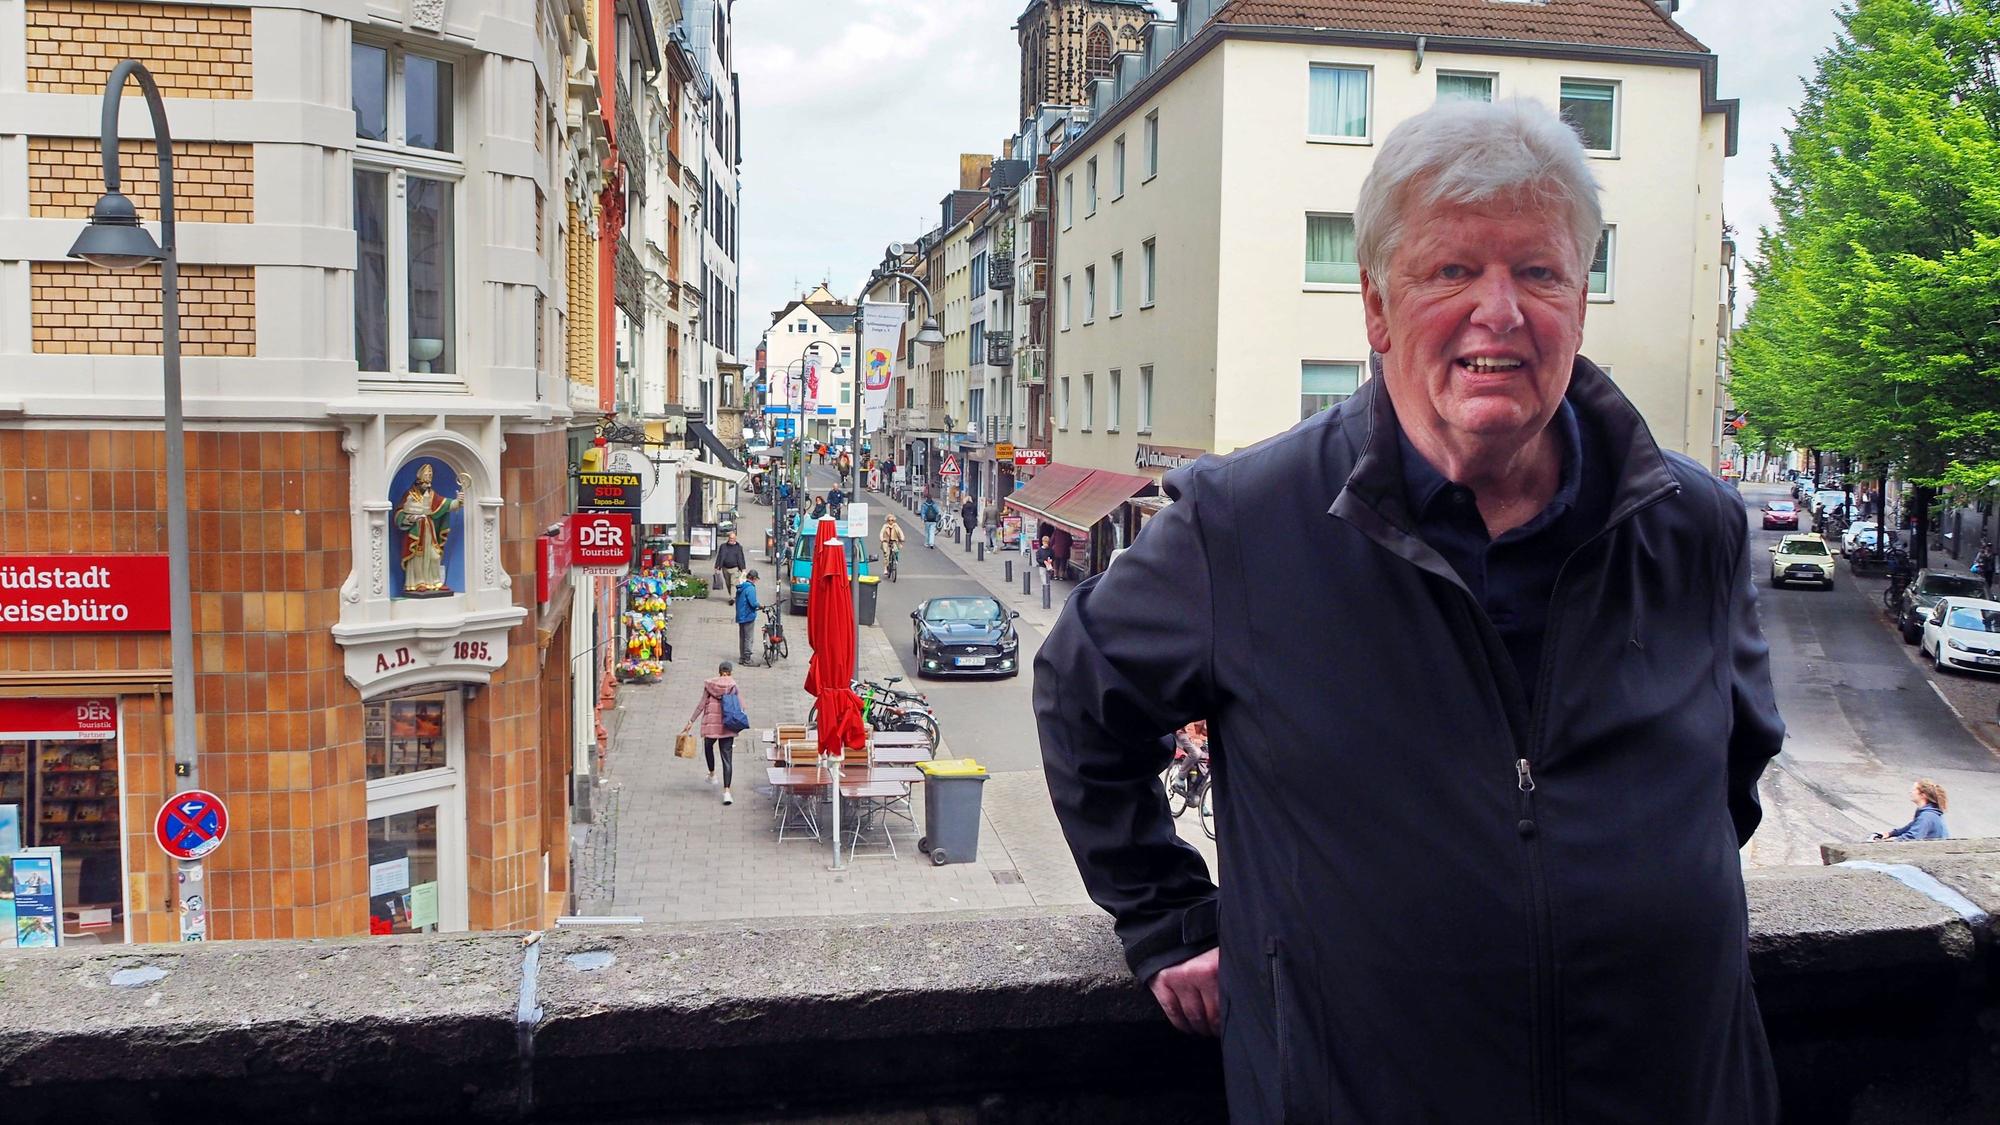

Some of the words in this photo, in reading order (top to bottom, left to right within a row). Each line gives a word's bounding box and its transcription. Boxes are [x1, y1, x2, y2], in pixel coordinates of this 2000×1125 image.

[580, 475, 639, 485] TURISTA
[595, 485, 622, 496] SÜD
[580, 527, 624, 546] DER
[580, 548, 624, 556] Touristik
[582, 566, 618, 575] Partner
[0, 565, 111, 589] üdstadt
[376, 647, 416, 673] A.D.
[453, 641, 491, 661] 1895.
[78, 706, 111, 720] DER
[78, 721, 112, 729] Touristik
